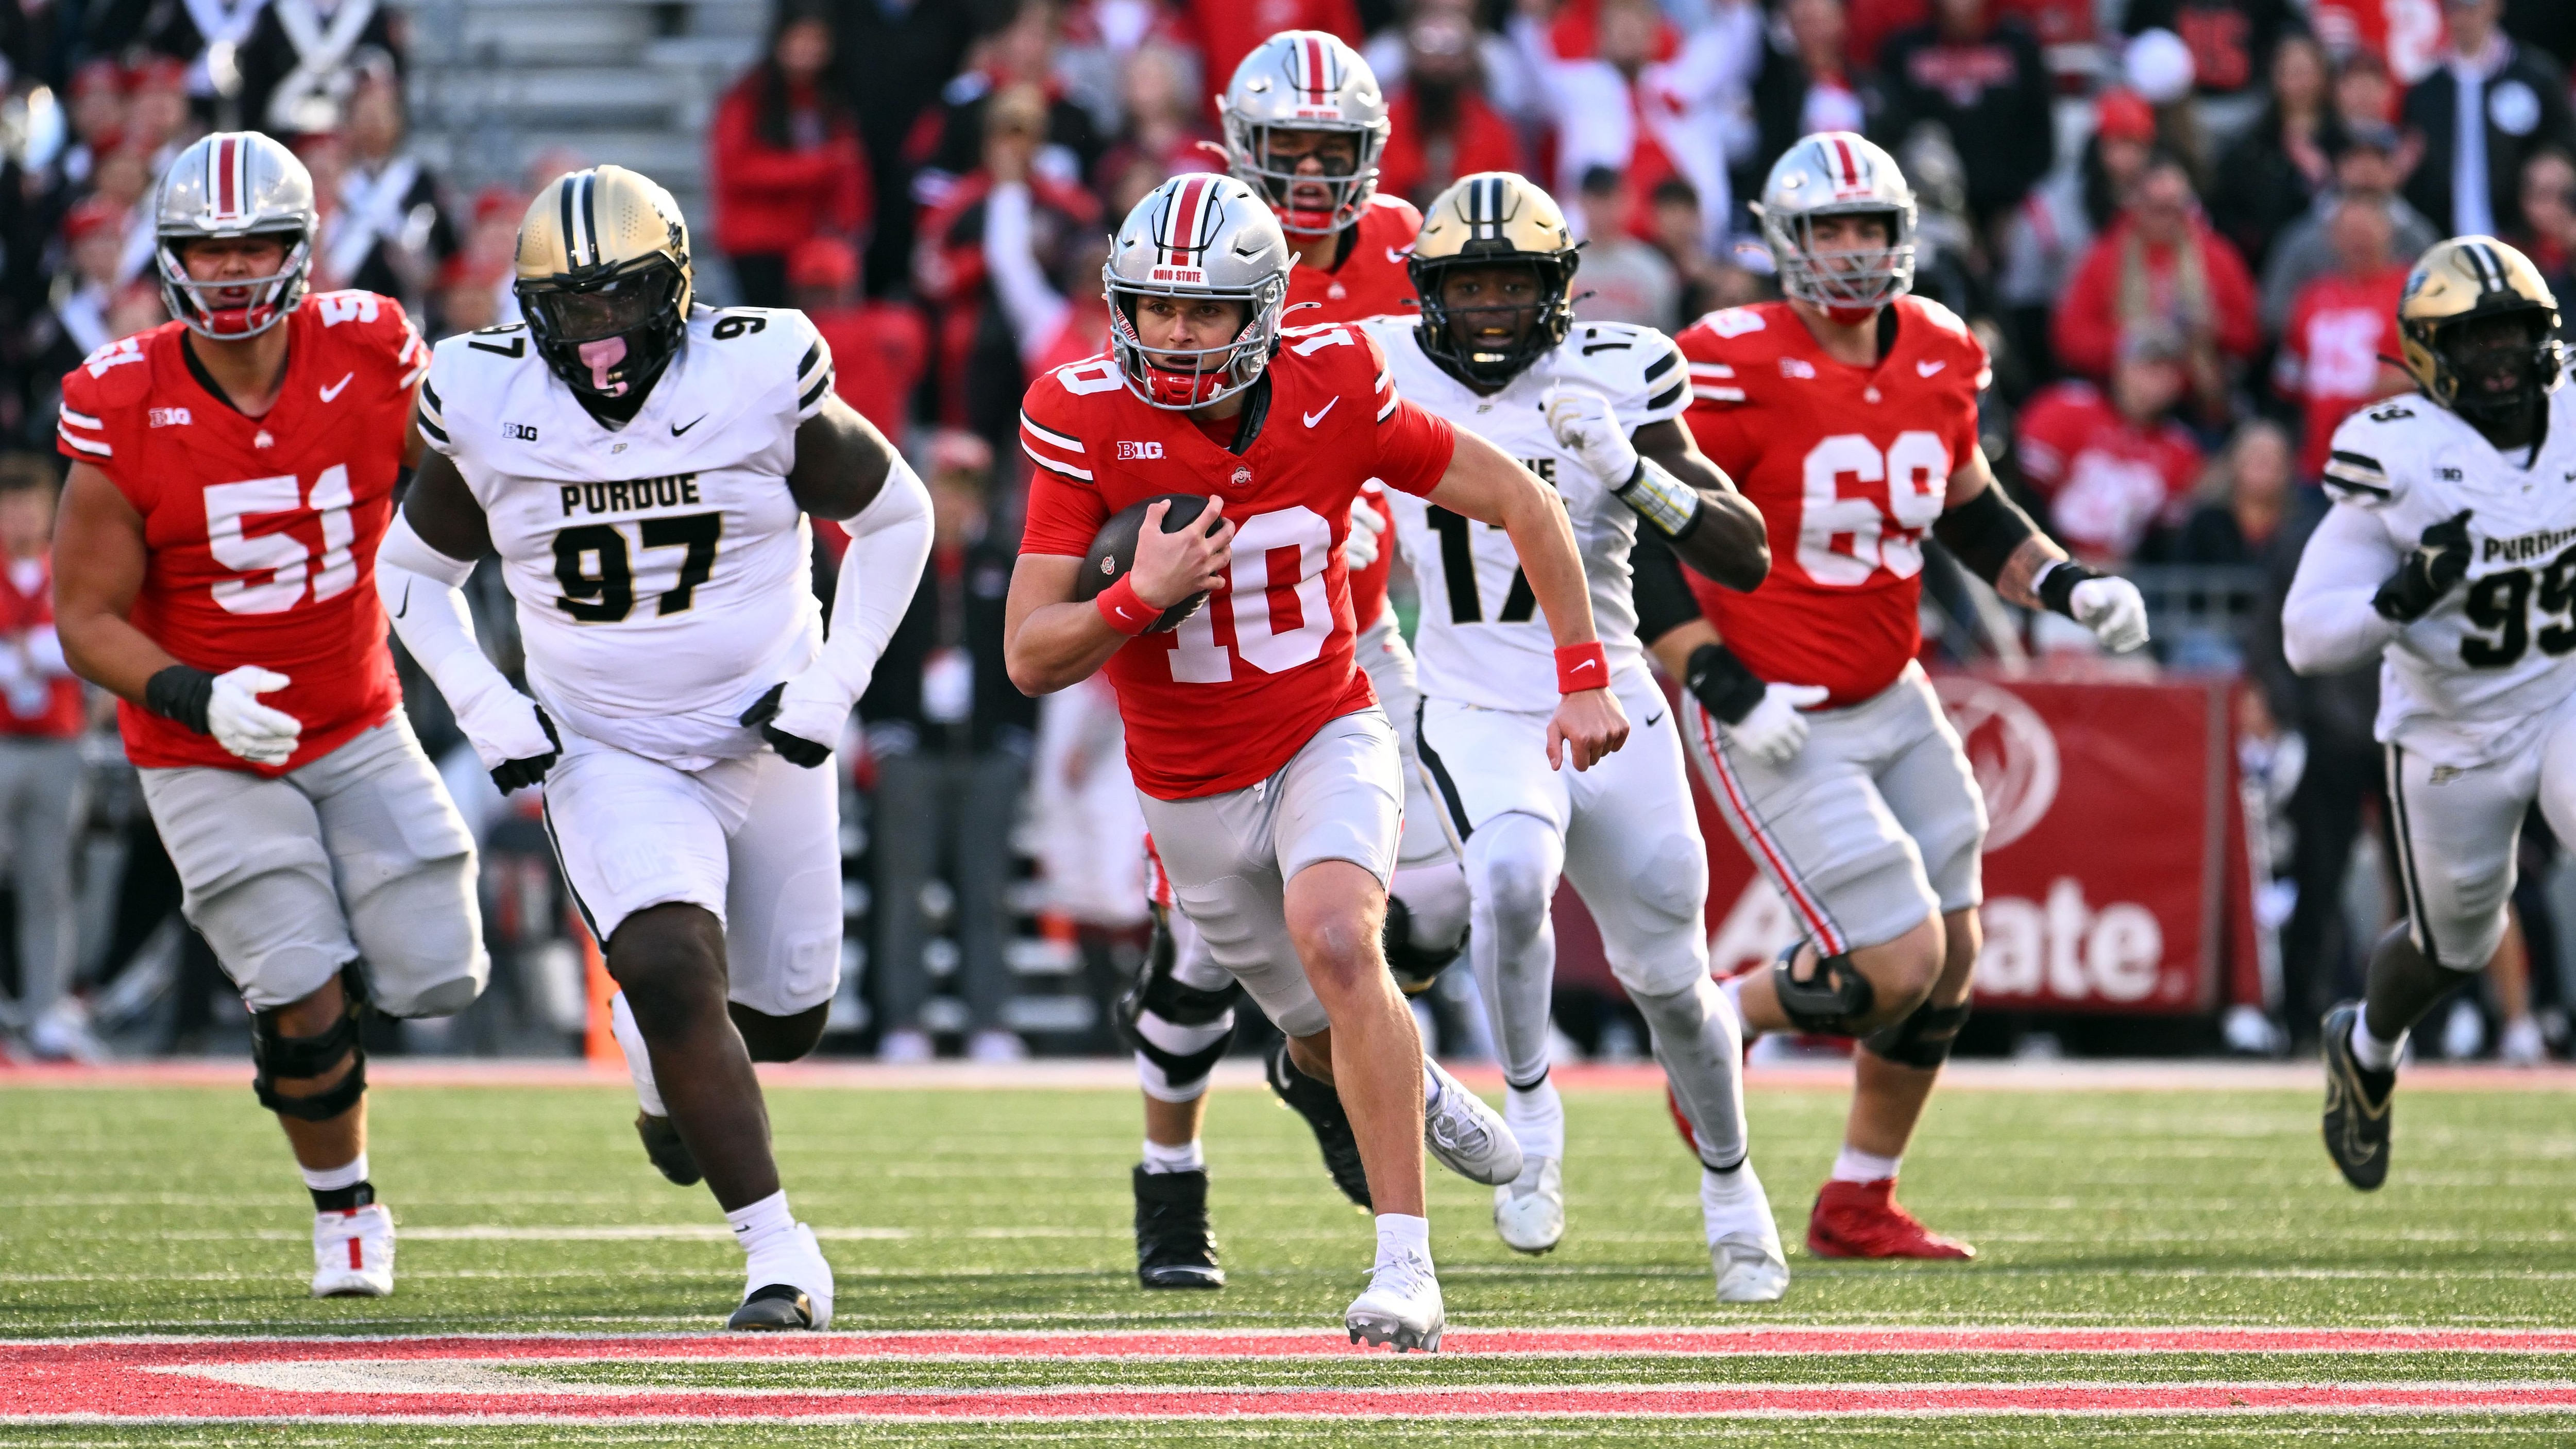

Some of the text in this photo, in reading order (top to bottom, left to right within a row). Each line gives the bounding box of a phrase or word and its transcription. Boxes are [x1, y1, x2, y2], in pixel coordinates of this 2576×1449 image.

[711, 309, 767, 341] 9
[1121, 323, 1138, 342] STATE
[1154, 269, 1201, 283] OHIO STATE
[203, 464, 358, 615] 51
[560, 472, 700, 517] PURDUE
[1797, 431, 1947, 586] 69
[551, 512, 724, 625] 97
[1167, 506, 1334, 683] 10
[1426, 497, 1569, 626] 1
[2460, 546, 2576, 667] 99
